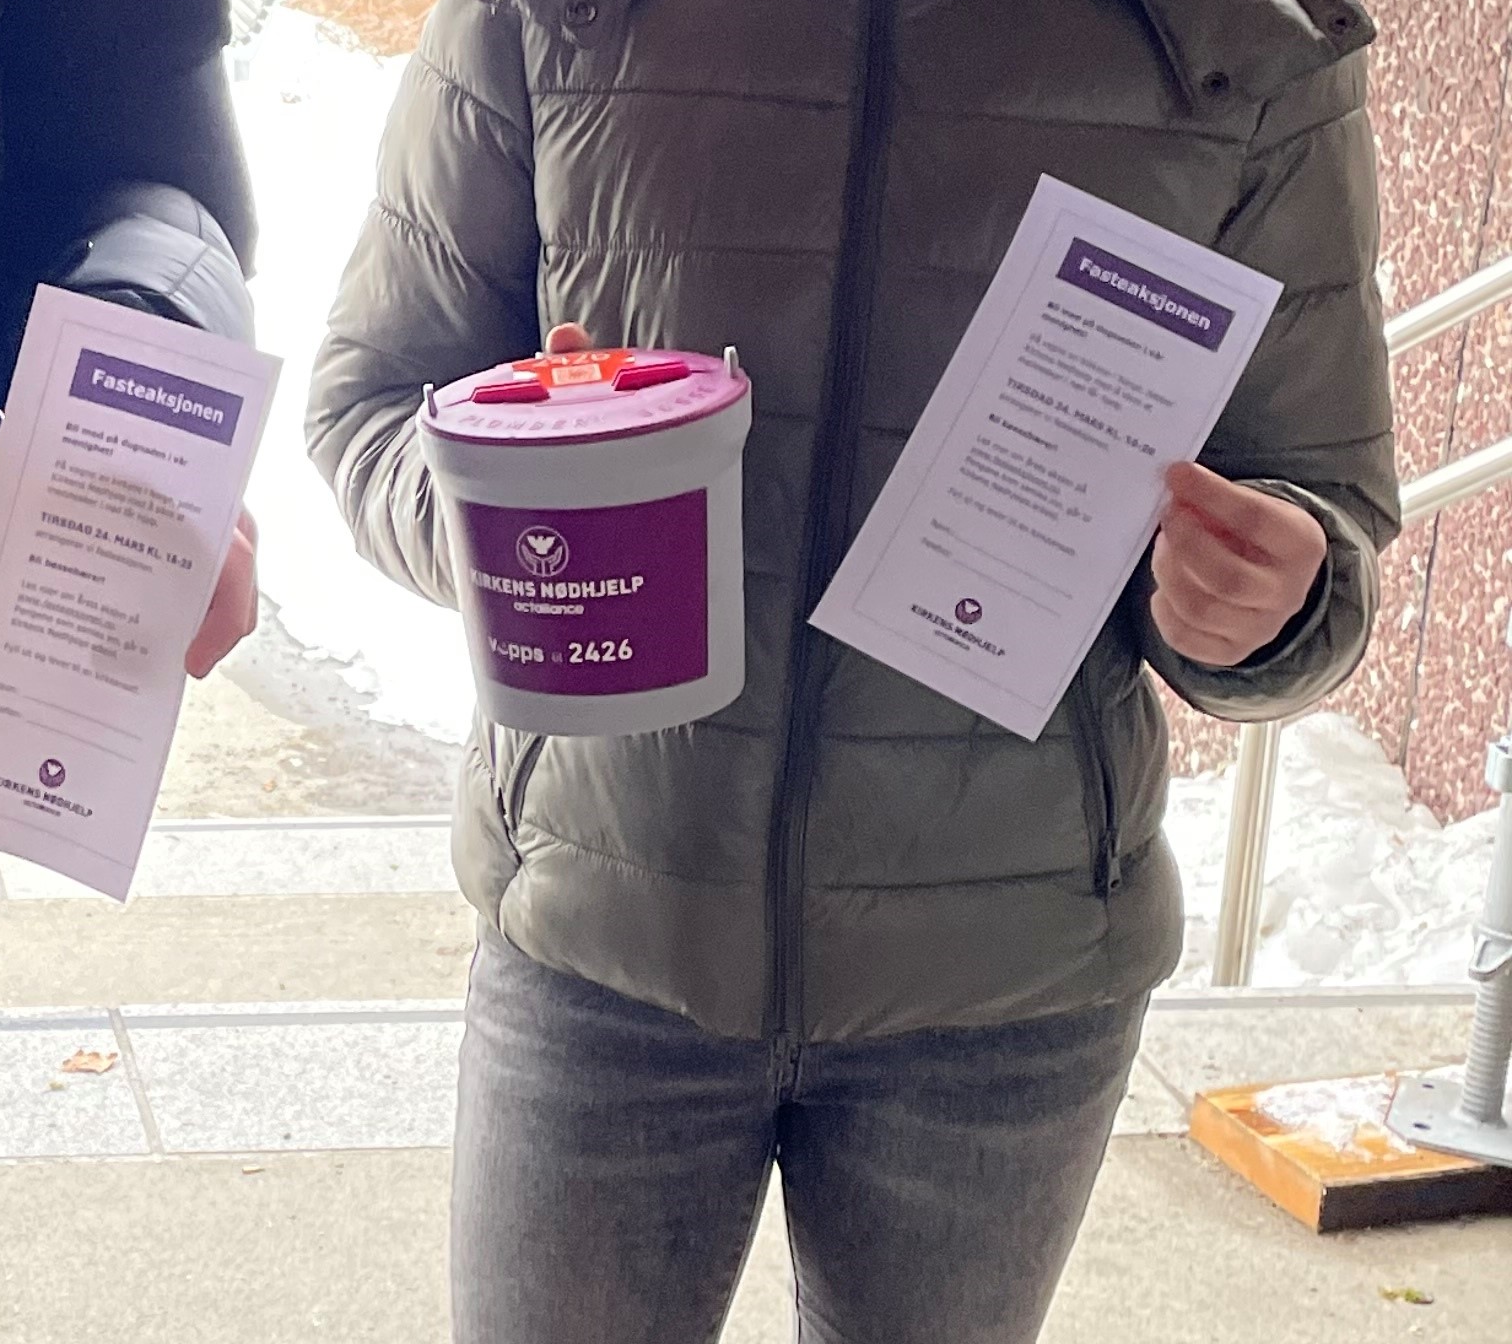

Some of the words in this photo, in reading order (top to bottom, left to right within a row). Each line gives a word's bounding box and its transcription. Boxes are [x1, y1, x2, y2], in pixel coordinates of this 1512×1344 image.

[1078, 256, 1212, 331] Fasteaksjonen
[91, 368, 225, 425] Fasteaksjonen
[41, 511, 93, 536] TIRSDAG
[113, 534, 145, 553] MARS
[470, 569, 536, 598] KIRKENS
[540, 576, 644, 599] NØDHJELP
[568, 638, 633, 664] 2426
[42, 791, 93, 818] NØDHJELP
